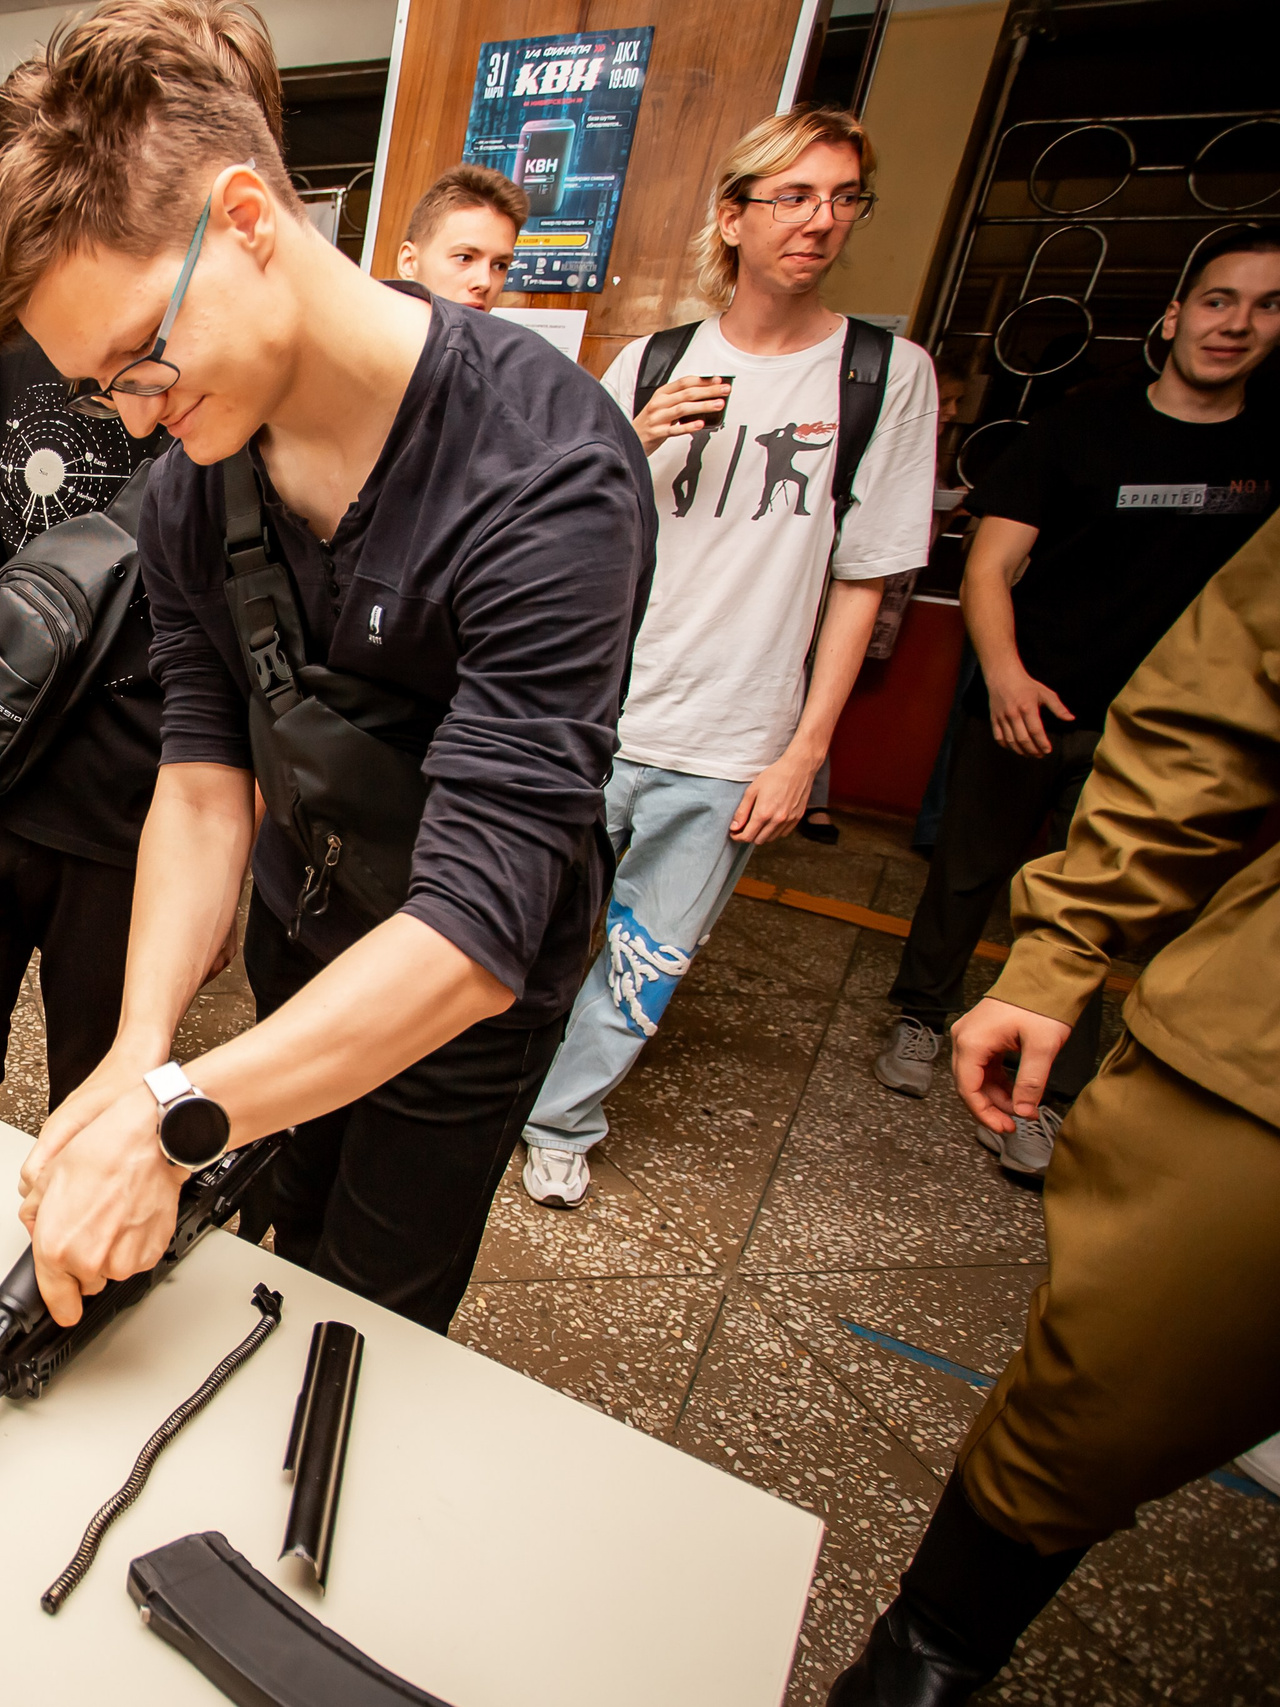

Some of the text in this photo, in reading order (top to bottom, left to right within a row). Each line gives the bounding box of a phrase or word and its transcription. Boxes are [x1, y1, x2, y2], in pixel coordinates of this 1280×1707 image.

[524, 44, 592, 60] 1/4 ФИНАЛА
[612, 40, 641, 66] ДКХ
[486, 52, 510, 87] 31
[512, 57, 605, 97] КВН
[608, 67, 639, 89] 19:00
[484, 86, 504, 100] МАРТА
[525, 158, 558, 173] КВН
[1118, 493, 1203, 505] SPIRITED
